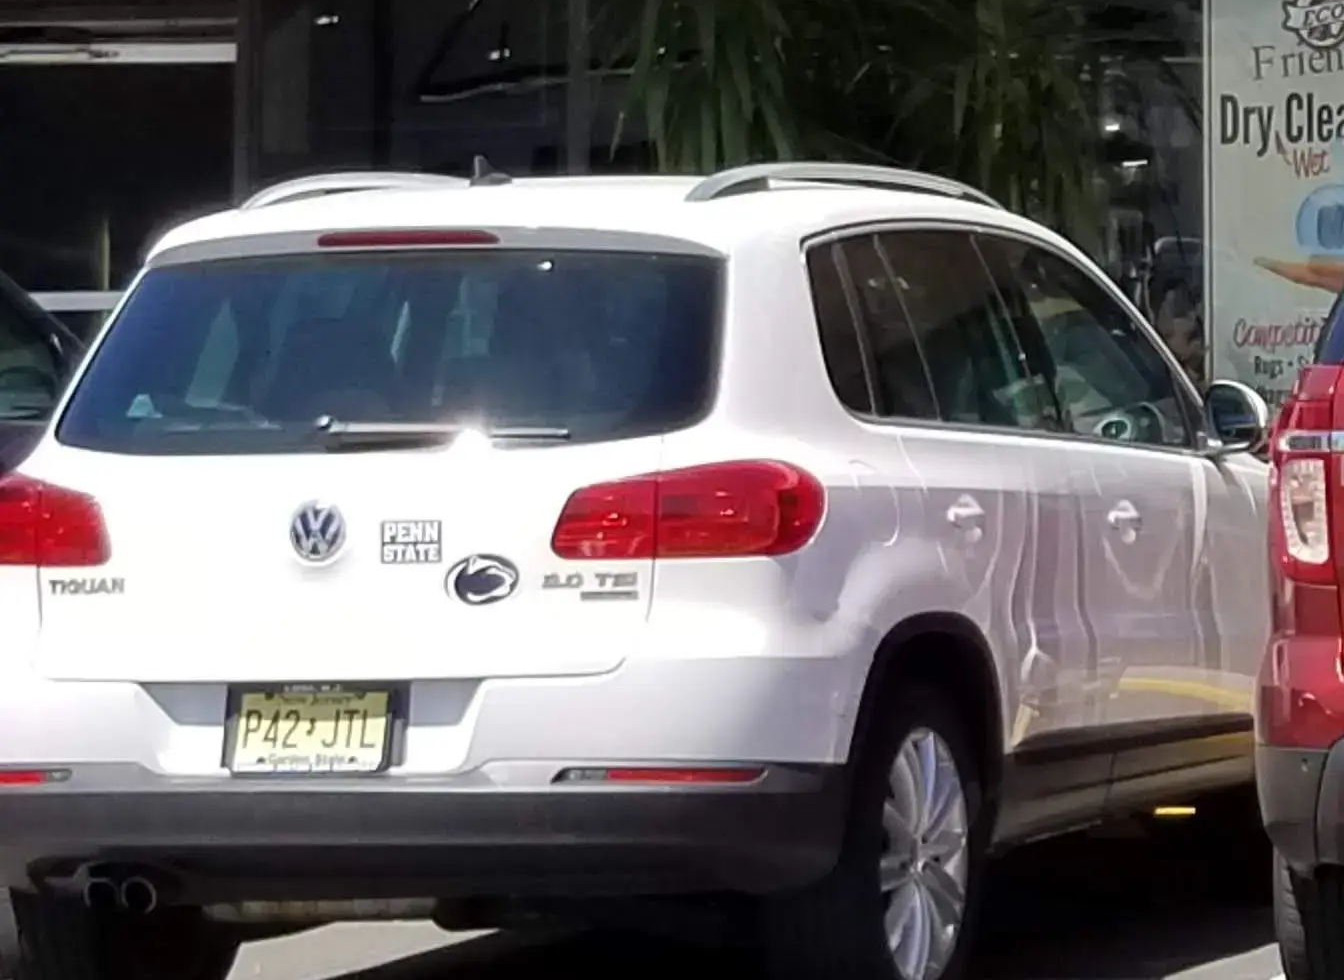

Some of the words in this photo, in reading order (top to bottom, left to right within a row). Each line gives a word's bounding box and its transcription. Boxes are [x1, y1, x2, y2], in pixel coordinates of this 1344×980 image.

[1303, 3, 1344, 27] ECO
[1220, 93, 1274, 157] Dry
[1293, 147, 1330, 178] Wet
[382, 521, 439, 543] PENN
[383, 544, 440, 563] STATE
